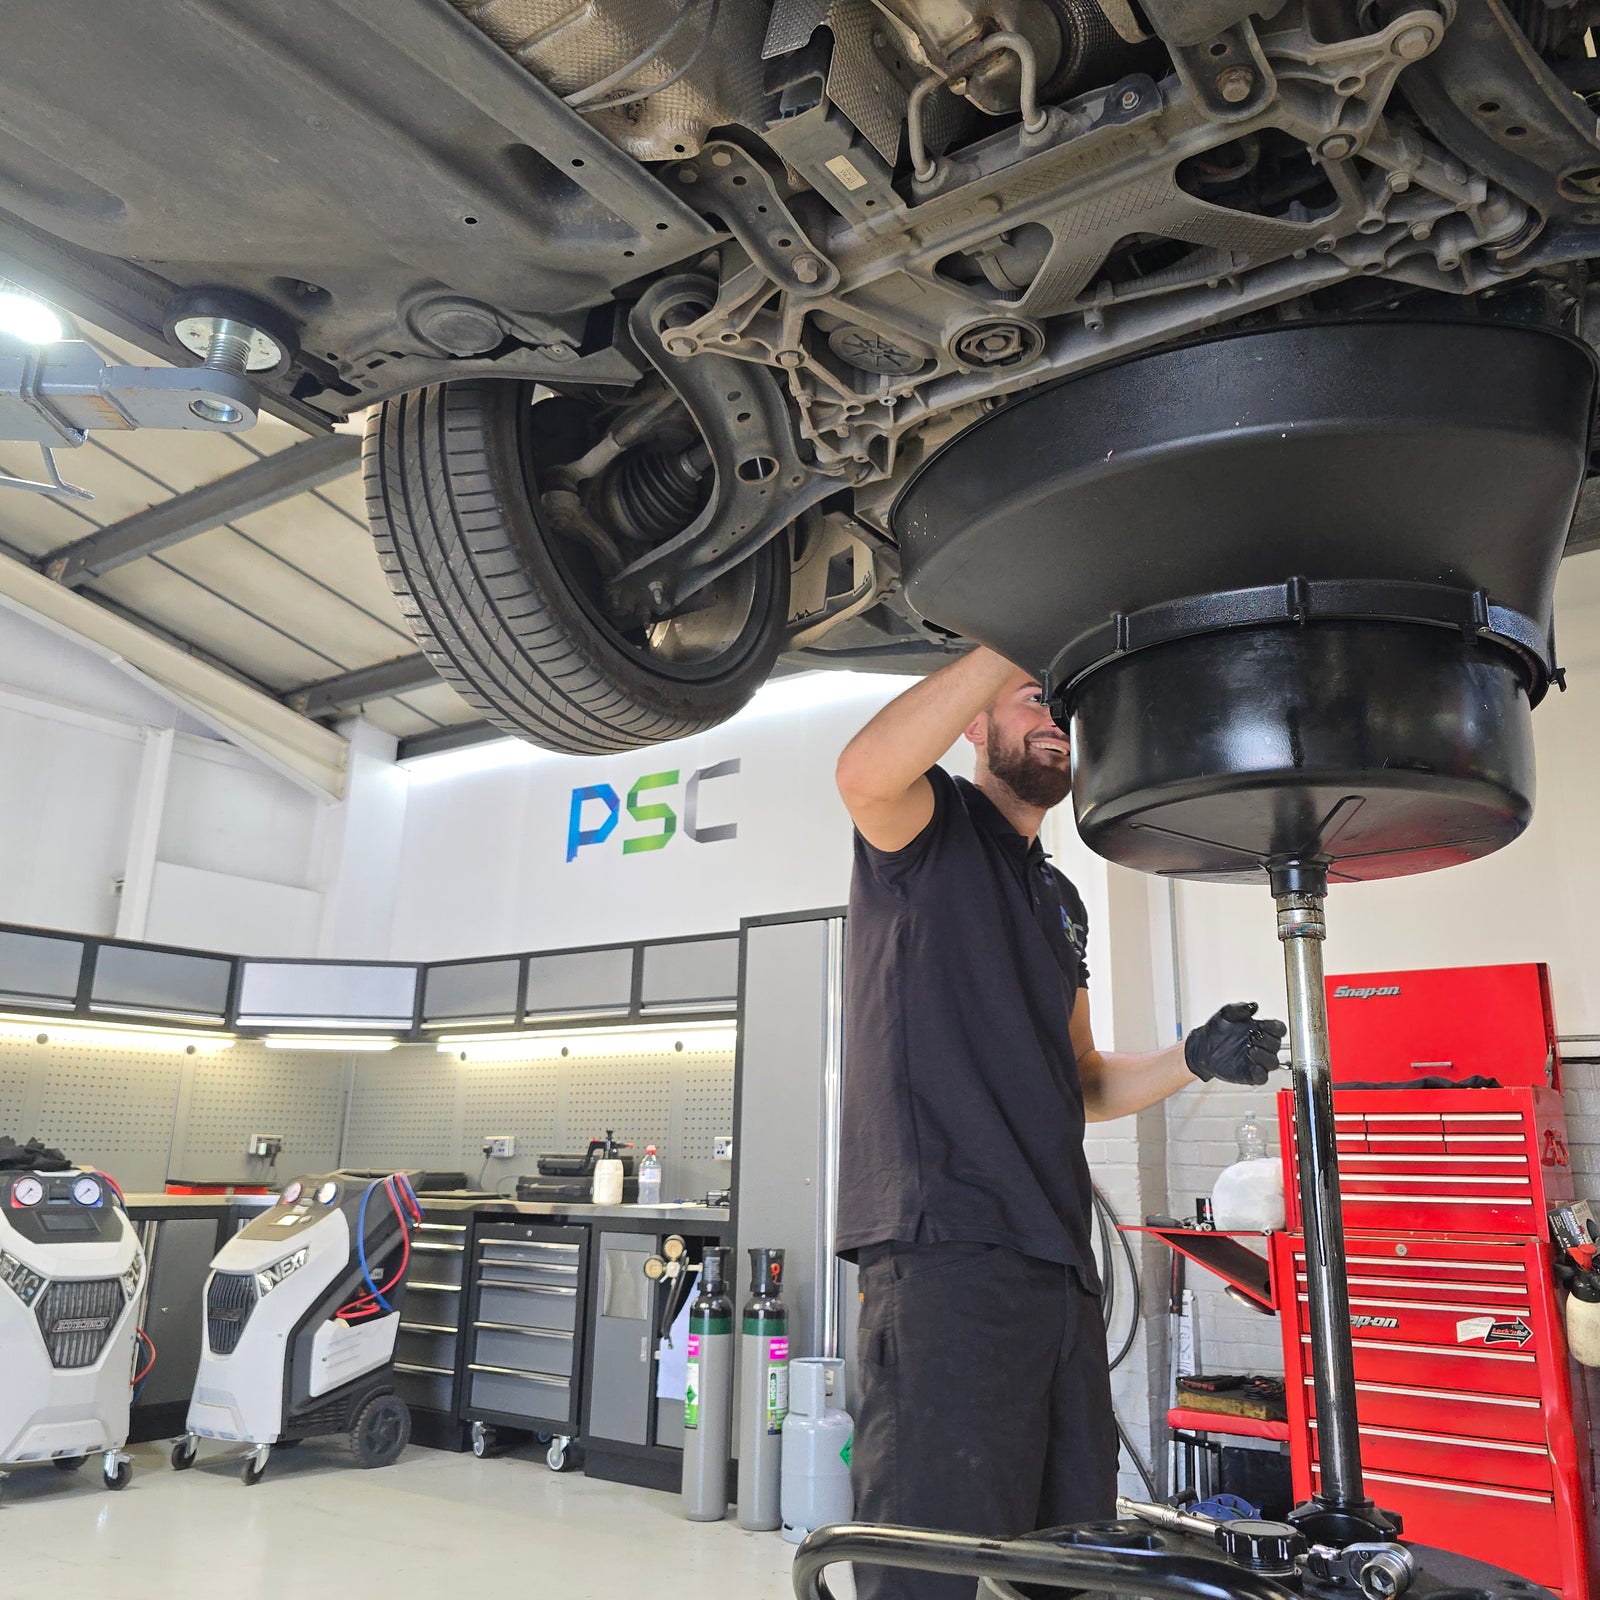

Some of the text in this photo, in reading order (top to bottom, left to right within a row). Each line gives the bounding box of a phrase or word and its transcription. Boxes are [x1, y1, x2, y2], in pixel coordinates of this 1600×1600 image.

[566, 757, 741, 863] PSC
[1333, 985, 1401, 1000] Snap-on
[267, 1248, 309, 1282] NEXT
[1350, 1314, 1398, 1329] ap-on
